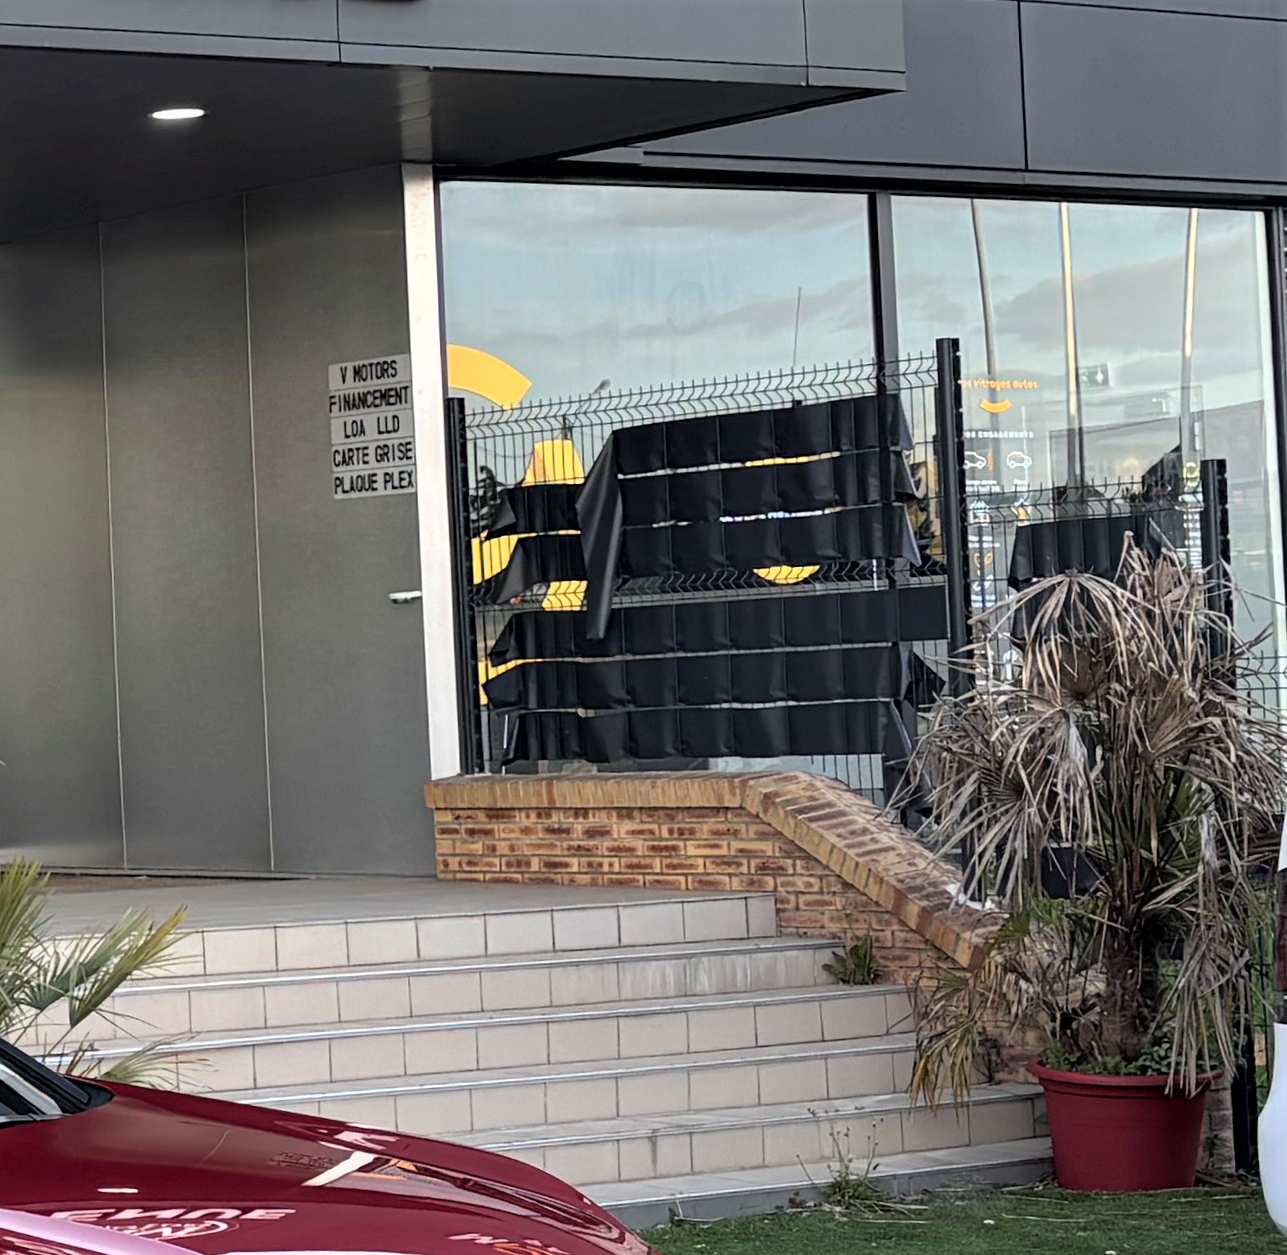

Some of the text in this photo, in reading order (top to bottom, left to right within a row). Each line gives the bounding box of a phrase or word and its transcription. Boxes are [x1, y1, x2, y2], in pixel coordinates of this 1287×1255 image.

[340, 360, 398, 385] V MOTORS
[329, 385, 410, 414] FINANCEMENT
[343, 414, 400, 439] LOA LLD
[333, 441, 413, 468] CARTE GRISE
[334, 470, 414, 495] PLAQUE PLEX
